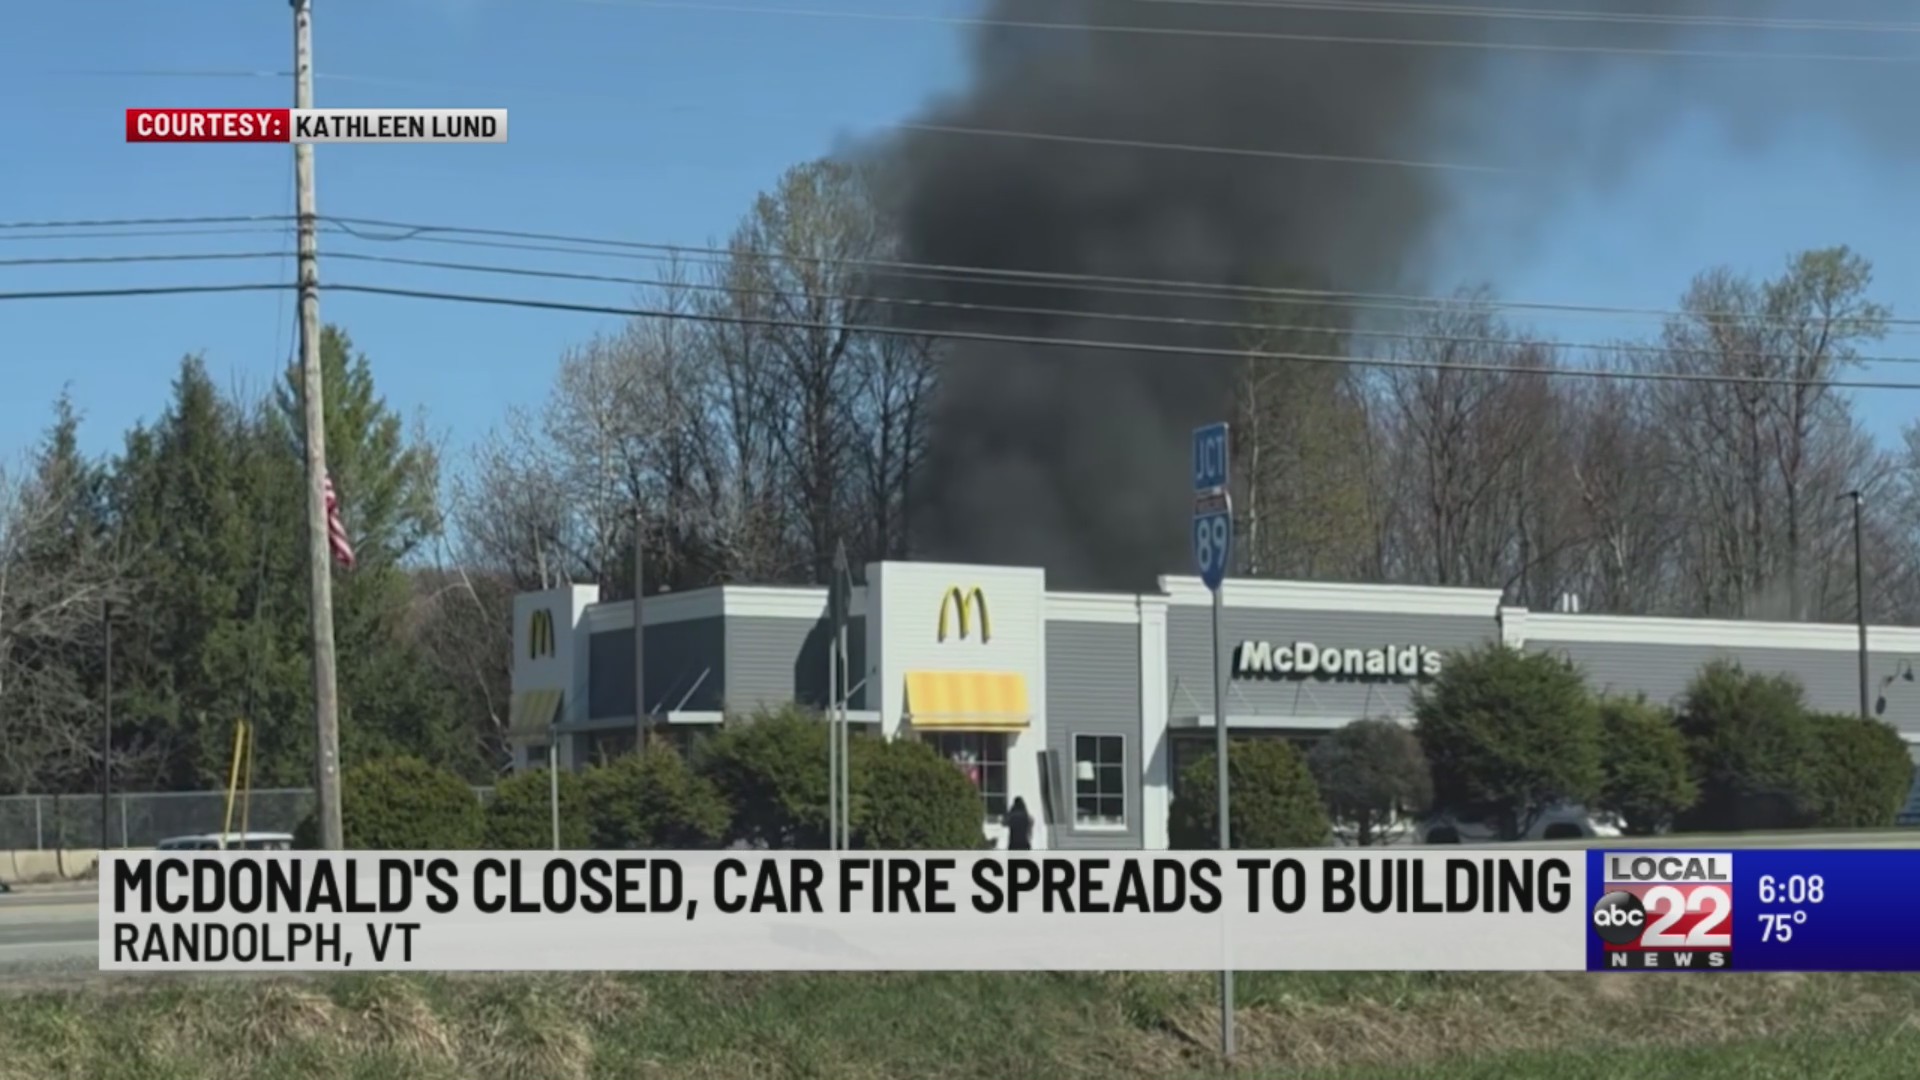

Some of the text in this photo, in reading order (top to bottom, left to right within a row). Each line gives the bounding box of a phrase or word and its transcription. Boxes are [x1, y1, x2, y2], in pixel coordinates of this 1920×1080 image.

[1197, 435, 1224, 480] JCT
[1198, 516, 1227, 572] 89
[1236, 640, 1442, 676] McDonald's
